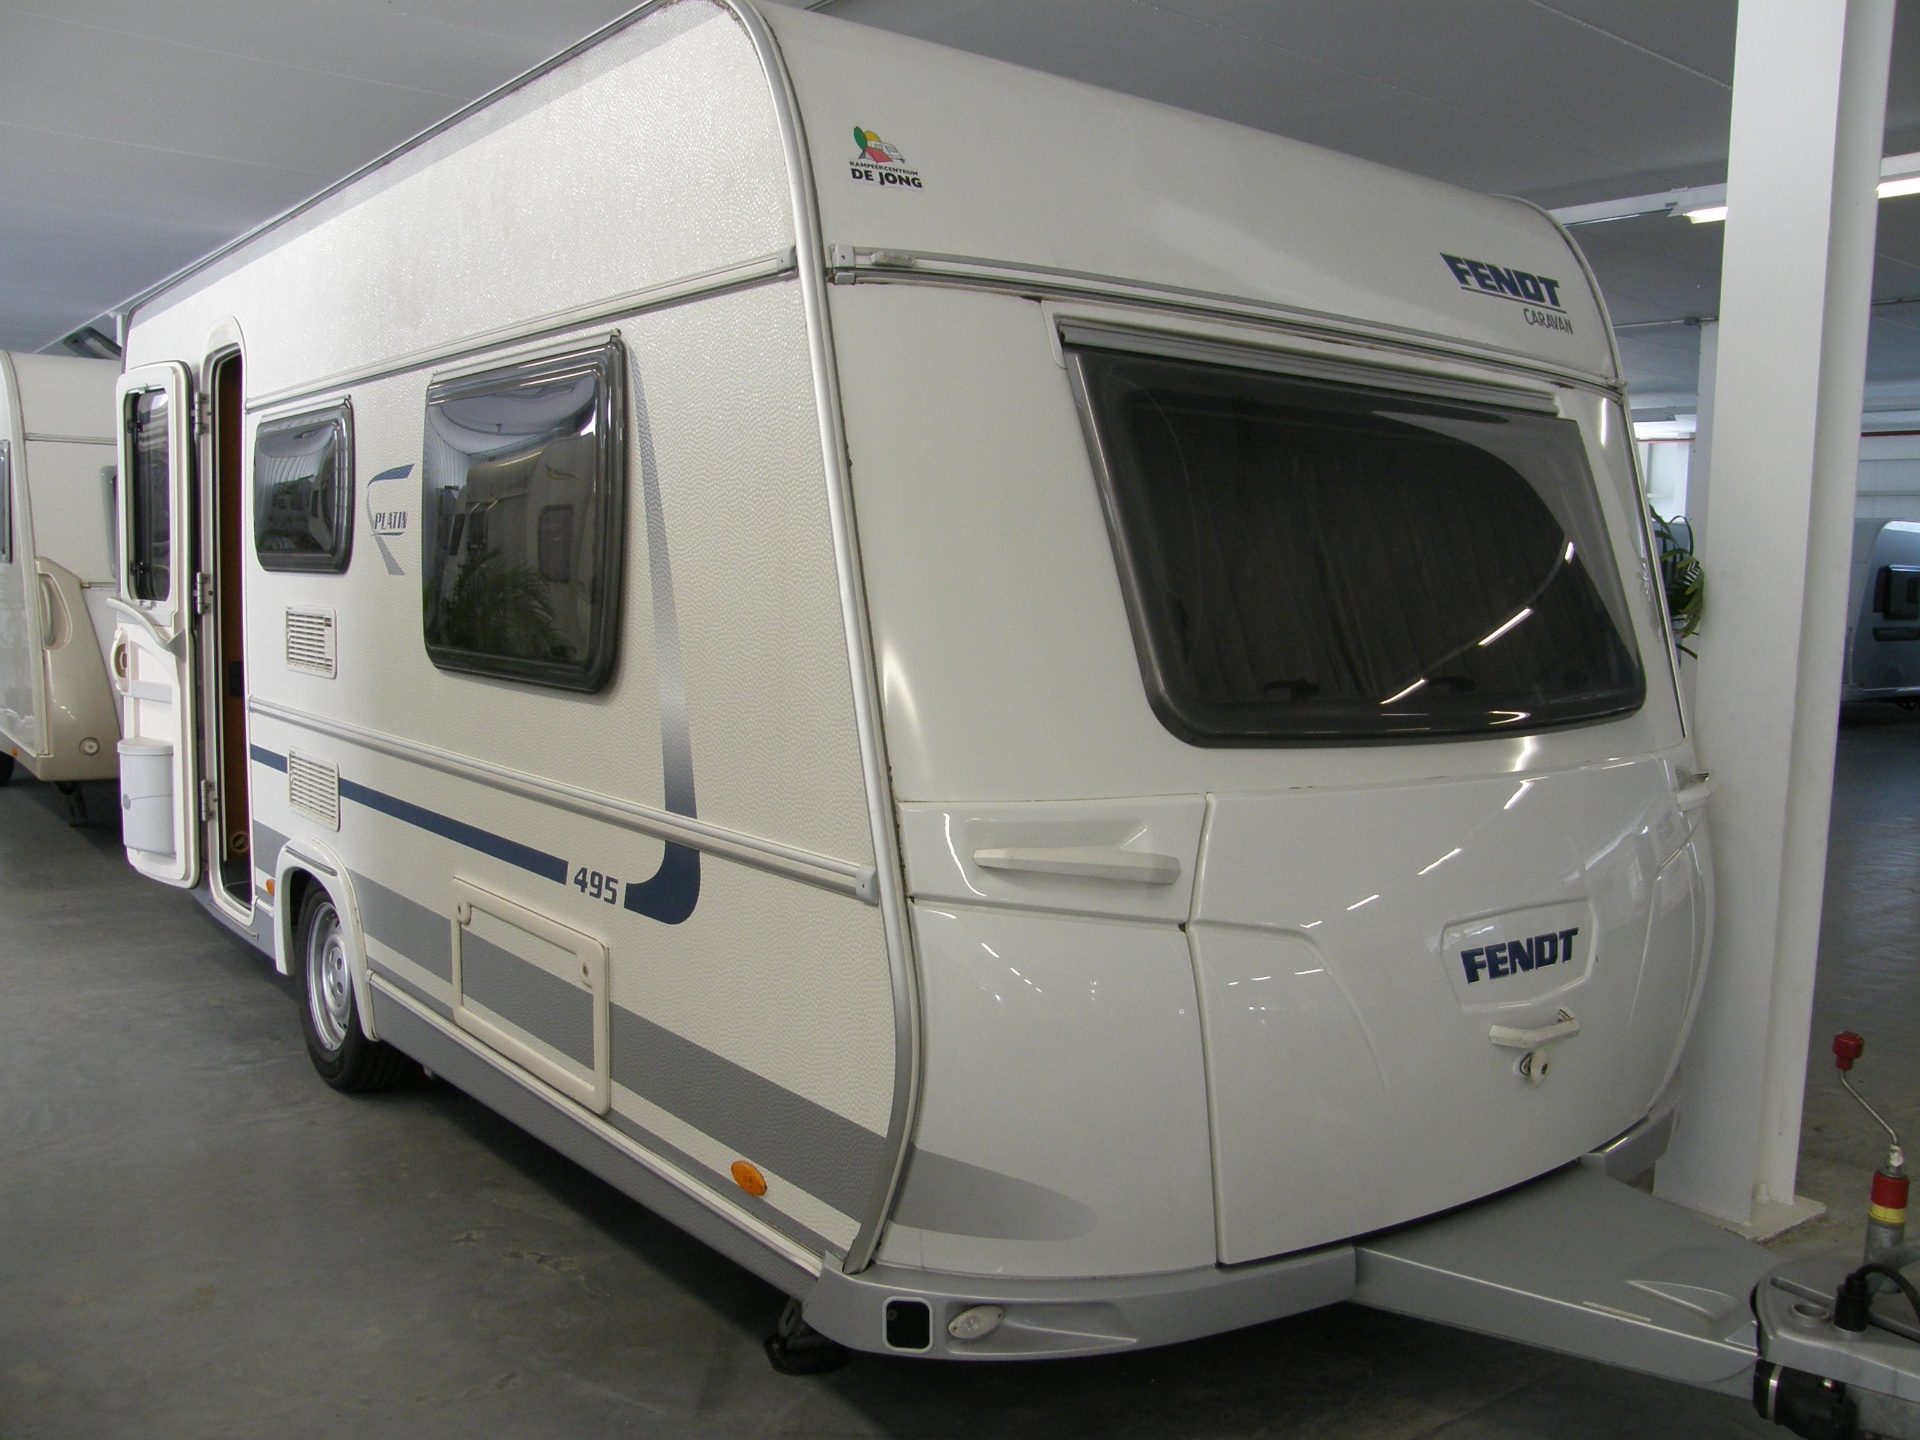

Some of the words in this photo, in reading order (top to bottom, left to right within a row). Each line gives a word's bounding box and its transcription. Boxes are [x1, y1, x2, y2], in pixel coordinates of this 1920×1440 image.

[849, 161, 918, 176] KAMPEERCENTRUM
[851, 168, 874, 181] DE
[879, 172, 922, 188] JONG
[1440, 252, 1560, 307] FENDT
[1523, 308, 1573, 334] CARAVAN
[374, 511, 407, 530] PLATIN
[573, 867, 618, 905] 495
[1461, 927, 1579, 985] FENDT
